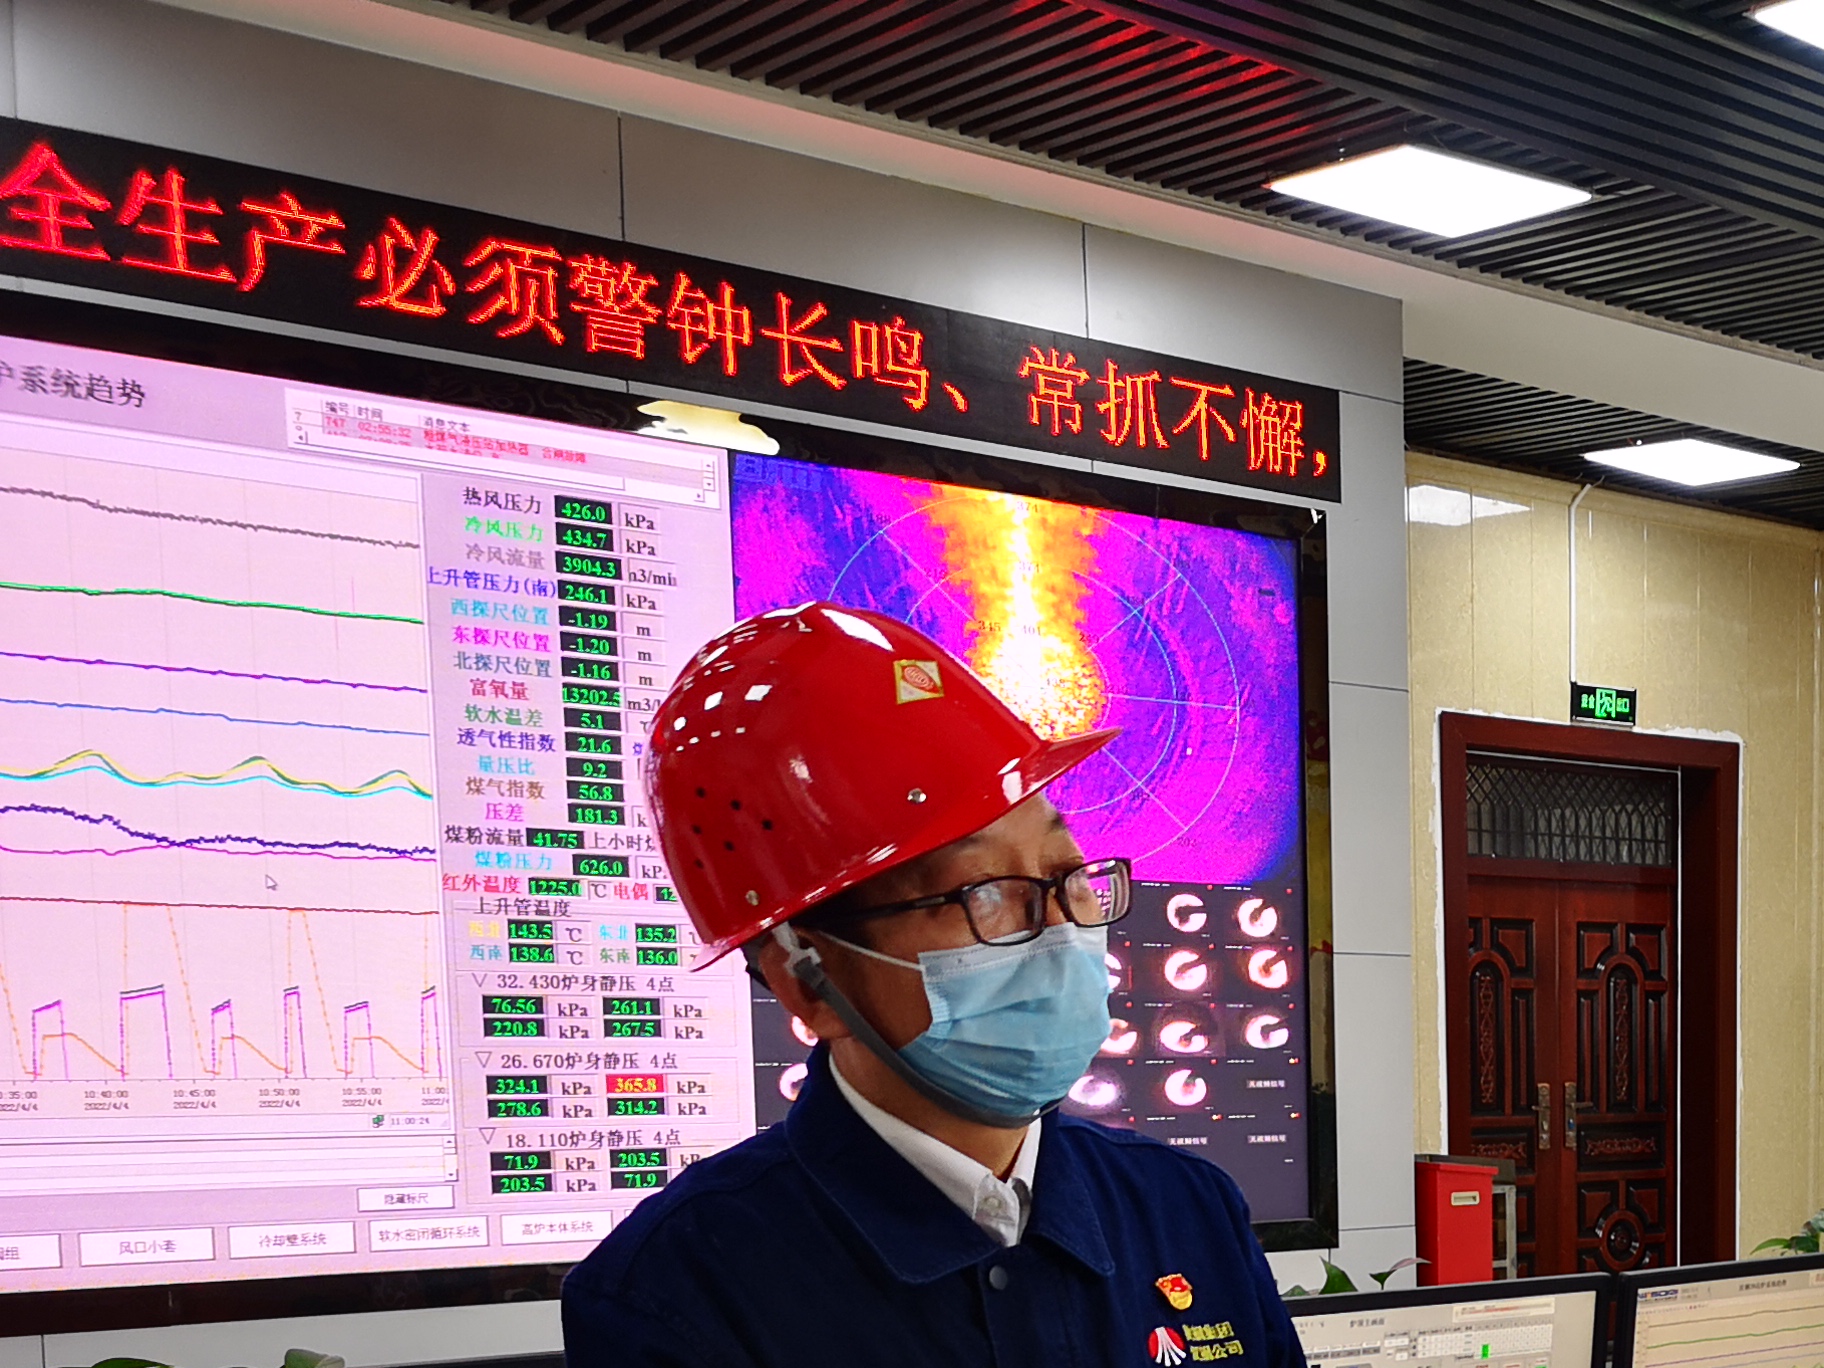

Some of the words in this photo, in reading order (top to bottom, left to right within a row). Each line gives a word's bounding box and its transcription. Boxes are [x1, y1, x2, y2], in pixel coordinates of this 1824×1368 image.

[463, 487, 541, 515] 热风压力
[562, 502, 606, 521] 426.0
[625, 512, 655, 530] kPa
[465, 516, 543, 543] 冷风压力
[563, 529, 607, 548] 434.7
[626, 539, 656, 556] kPa
[466, 543, 545, 570] 冷风流量
[563, 556, 615, 578] 3904.3
[566, 585, 607, 604] 246.1
[627, 594, 656, 611] kPa
[451, 598, 549, 626] 西探尺位置
[568, 613, 608, 630] -1.19
[453, 625, 550, 652] 东探尺位置
[637, 625, 650, 636] m
[569, 638, 609, 655] -1.20
[454, 651, 552, 678] 北探尺位置
[638, 651, 652, 662] m
[571, 663, 611, 680] -1.16
[639, 675, 653, 686] m
[470, 679, 530, 701] 富氧量
[465, 703, 543, 727] 软水温差
[581, 713, 603, 729] 5.1
[457, 728, 556, 752] 透气性指数
[578, 736, 611, 753] 21.6
[478, 756, 536, 776] 量压比
[583, 762, 607, 778] 9.2
[466, 777, 545, 800] 煤气指数
[579, 785, 613, 801] 56.8
[485, 802, 525, 822] 压差
[576, 808, 618, 824] 181.3
[445, 825, 524, 847] 煤粉流量
[533, 833, 578, 848] 41.75
[474, 851, 552, 871] 煤粉压力
[579, 860, 623, 876] 626.0
[642, 865, 667, 879] kP
[442, 873, 522, 894] 红外温度
[529, 880, 582, 896] 1225.0
[474, 897, 571, 917] 上升管温度
[509, 923, 552, 940] 143.5
[636, 927, 677, 943] 135.2
[510, 945, 555, 962] 138.6
[637, 949, 678, 965] 136.0
[497, 974, 636, 992] 32.430炉身静压
[491, 998, 536, 1014] 76.56
[558, 1003, 588, 1017] kPa
[612, 999, 652, 1015] 261.1
[673, 1004, 702, 1018] kPa
[492, 1021, 538, 1037] 220.8
[559, 1025, 589, 1039] kPa
[612, 1021, 655, 1037] 267.5
[675, 1025, 703, 1039] kPa
[501, 1052, 639, 1070] 26.670炉身静压
[495, 1078, 539, 1094] 324.1
[561, 1082, 592, 1096] kPa
[615, 1078, 657, 1093] 365.8
[677, 1081, 706, 1094] kPa
[497, 1102, 541, 1117] 278.6
[563, 1104, 592, 1118] kPa
[615, 1100, 658, 1115] 314.2
[678, 1102, 706, 1116] kPa
[507, 1129, 643, 1148] 18.110炉身静压
[503, 1154, 539, 1170] 71.9
[565, 1157, 595, 1171] kPa
[618, 1152, 660, 1167] 203.5
[680, 1154, 700, 1167] kP
[500, 1177, 545, 1193] 203.5
[566, 1179, 596, 1193] kPa
[624, 1173, 657, 1188] 71.9
[378, 1226, 480, 1242] 软水密闭循环系统
[521, 1220, 594, 1236] 高炉本体系统
[119, 1239, 177, 1255] 风口小套
[259, 1232, 327, 1248] 冷却壁系统
